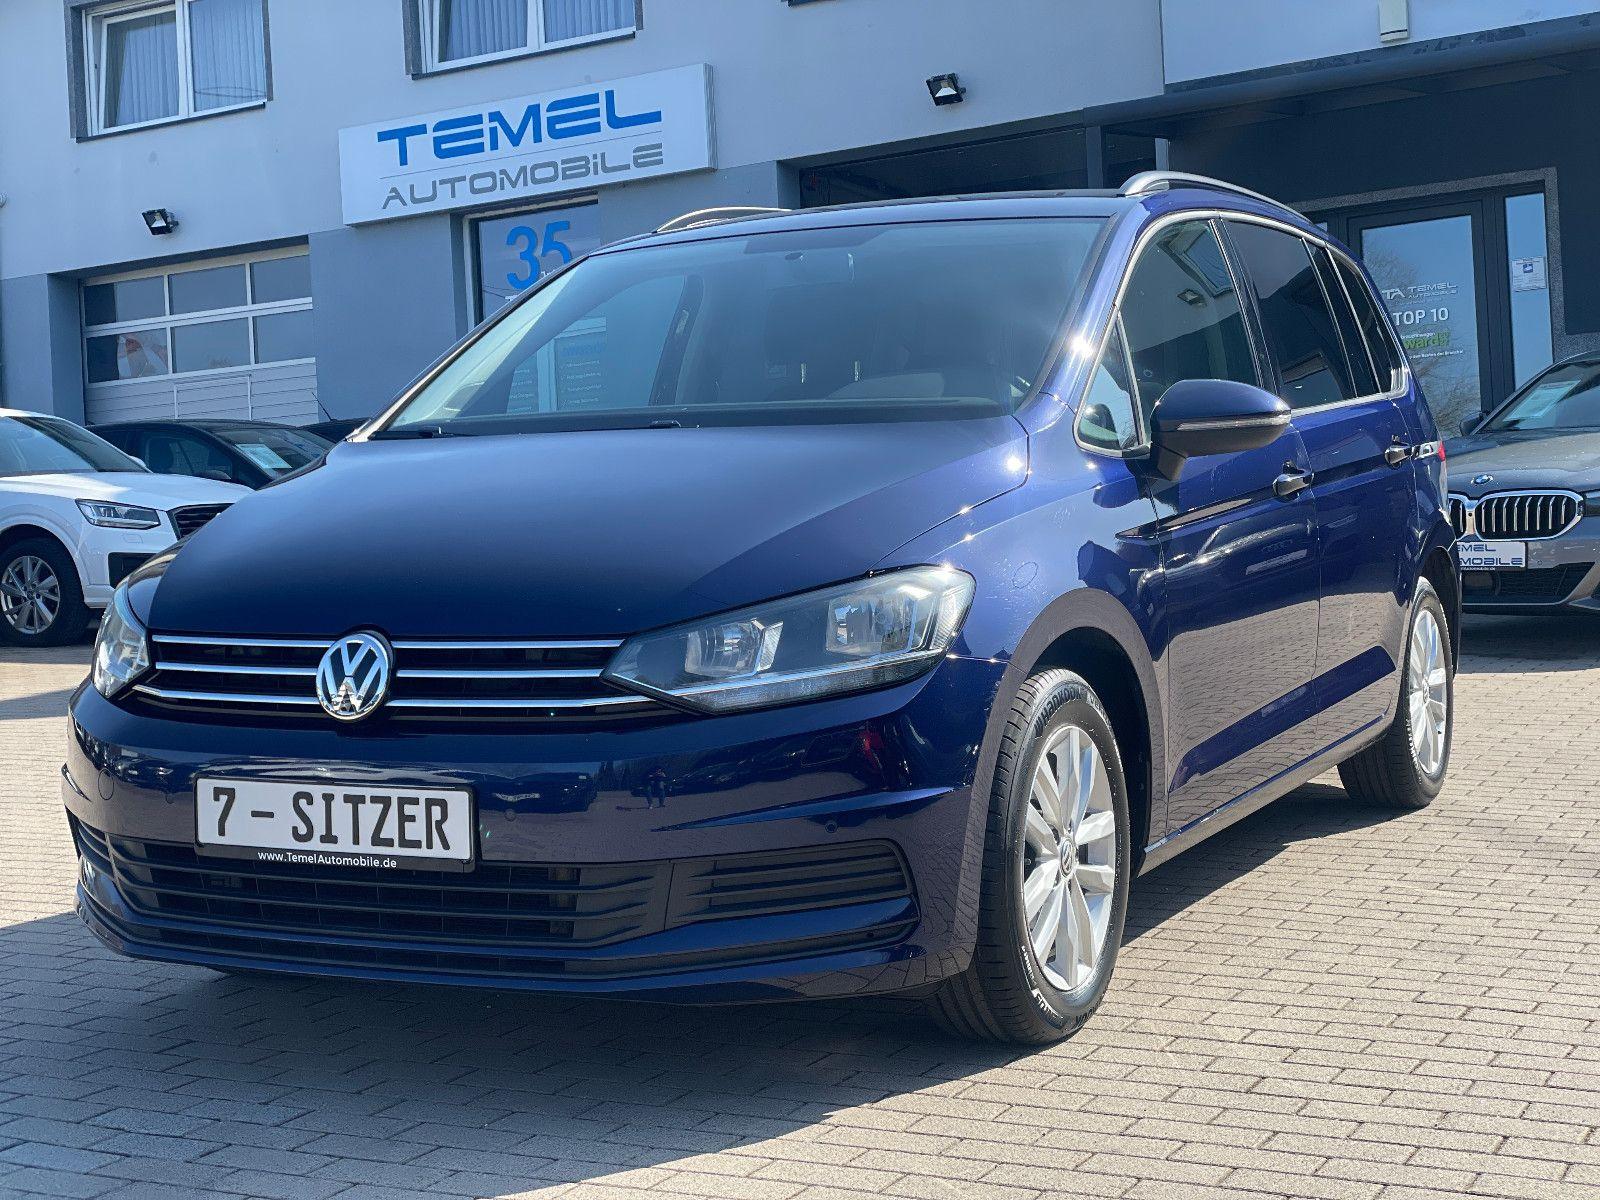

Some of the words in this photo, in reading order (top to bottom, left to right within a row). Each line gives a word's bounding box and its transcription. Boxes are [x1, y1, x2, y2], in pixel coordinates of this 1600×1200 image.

[377, 90, 662, 166] TEMEL
[506, 220, 573, 291] 35
[1407, 282, 1457, 293] TEMEL
[1393, 309, 1426, 326] TOP
[1430, 307, 1449, 322] 10
[1403, 331, 1440, 349] ward
[1457, 544, 1497, 552] MEL
[1460, 557, 1523, 566] MOBILE
[213, 786, 236, 836] 7
[291, 791, 451, 851] SITZER
[257, 851, 397, 869] www.TemelAutomobile.de
